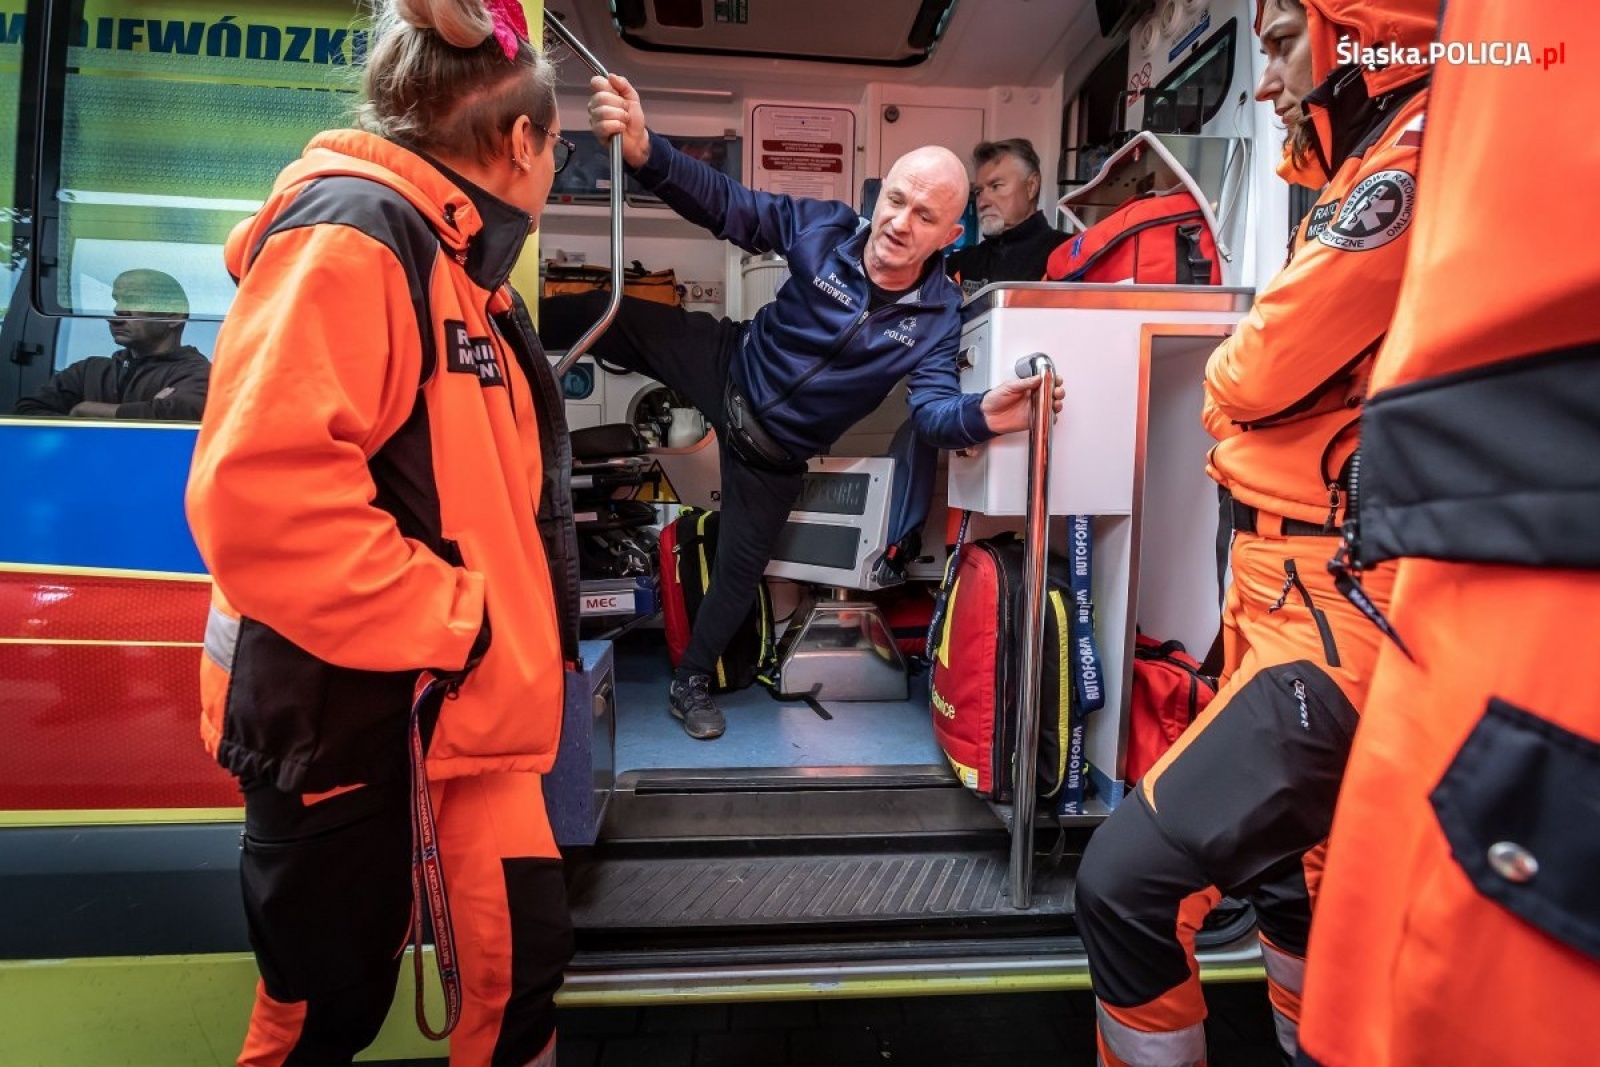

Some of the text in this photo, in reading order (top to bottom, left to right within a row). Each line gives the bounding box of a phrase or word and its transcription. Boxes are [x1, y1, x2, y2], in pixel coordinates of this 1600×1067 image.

[812, 275, 853, 306] KATOWICE
[883, 328, 916, 348] POLICJA
[586, 597, 617, 608] MEC
[1079, 636, 1100, 700] AUTOFORM
[1068, 726, 1083, 789] AUTOFORM
